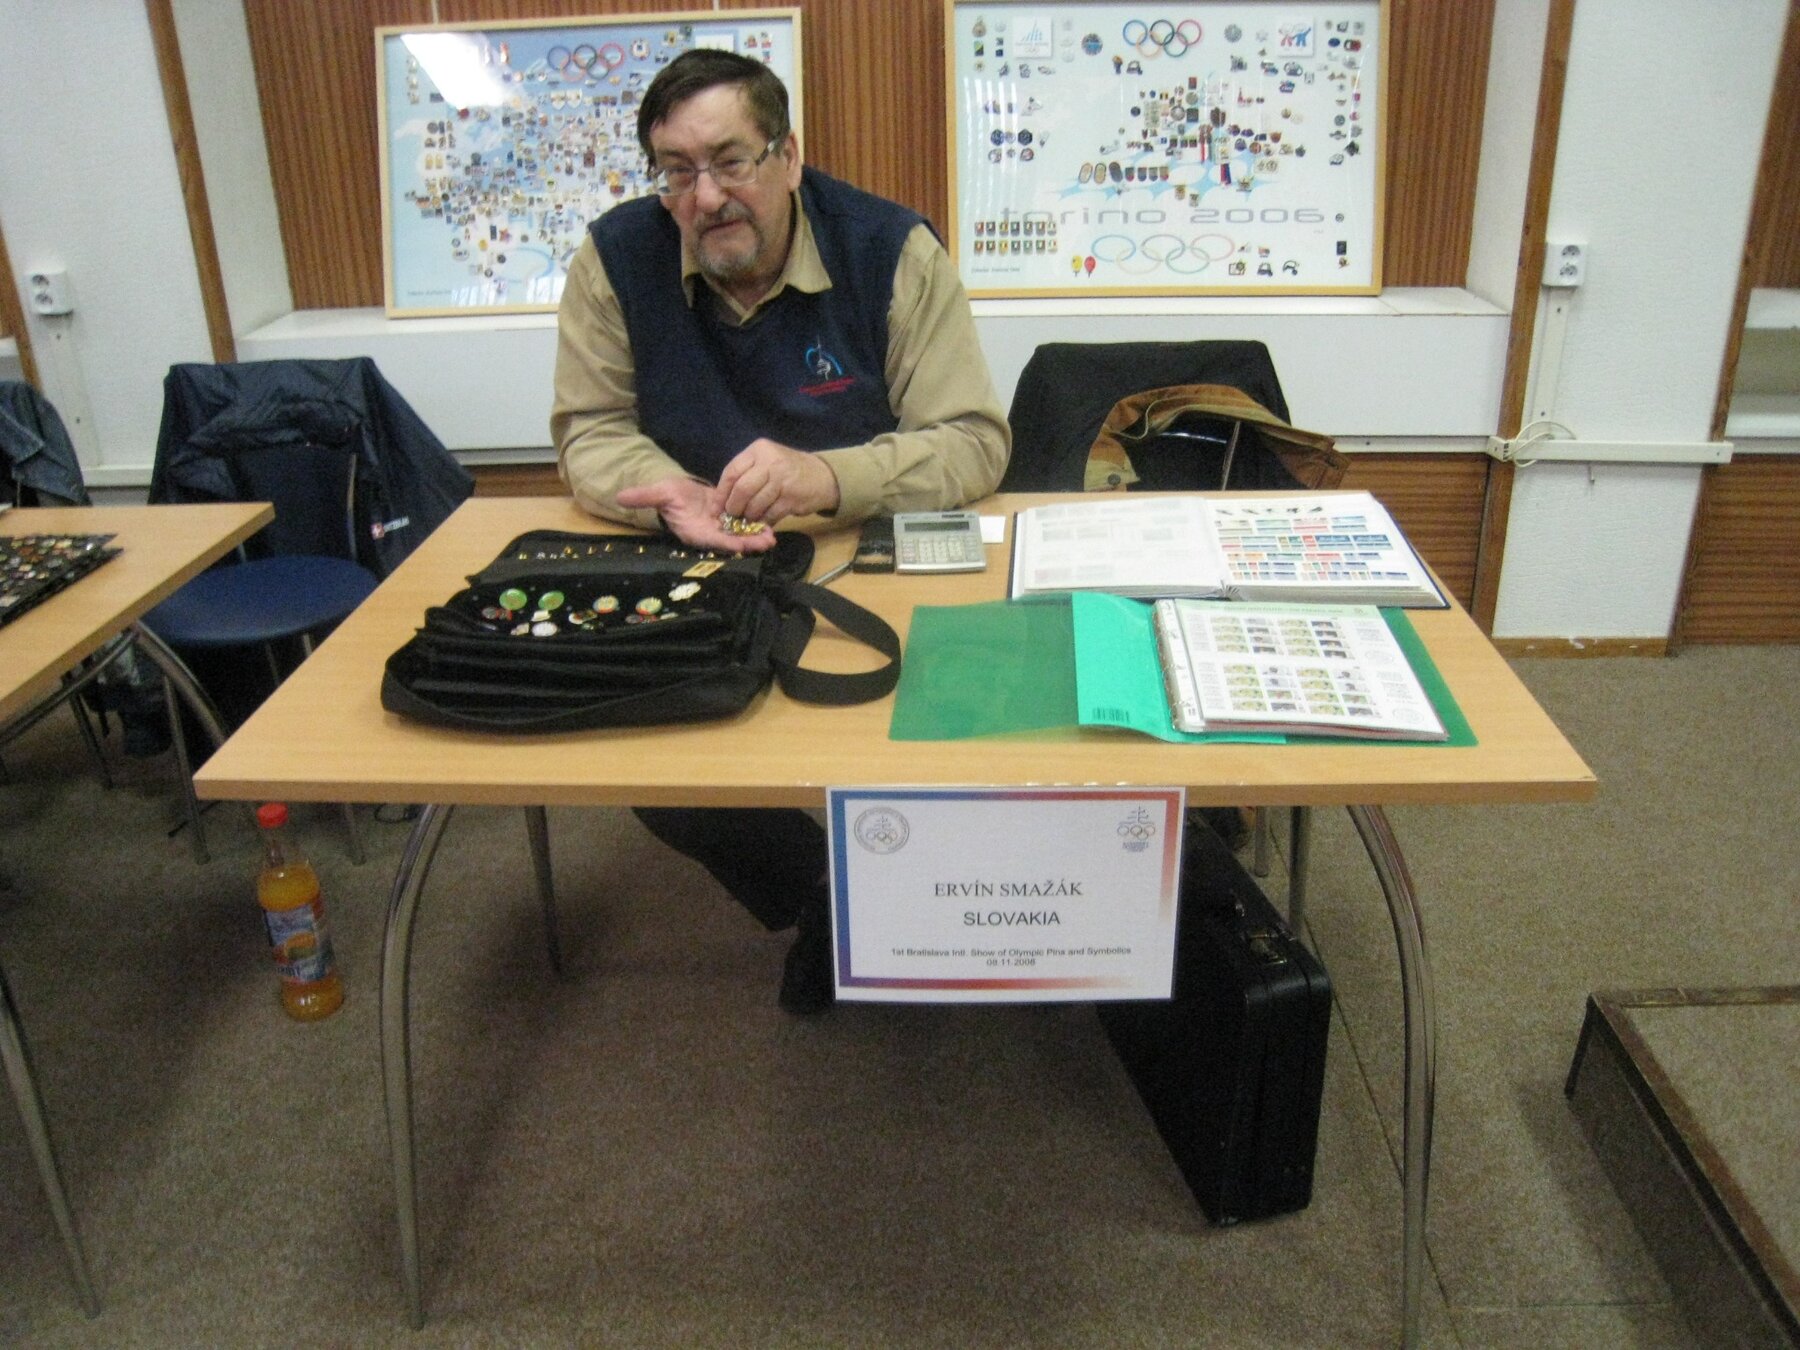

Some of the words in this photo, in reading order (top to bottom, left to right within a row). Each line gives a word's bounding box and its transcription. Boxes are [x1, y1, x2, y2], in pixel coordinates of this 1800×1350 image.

[1189, 207, 1325, 225] 2006
[934, 879, 994, 898] ERVÍN
[999, 878, 1084, 898] SMAŽÁK
[963, 911, 1061, 927] SLOVAKIA
[891, 947, 905, 957] 1st
[906, 947, 950, 958] Bratislava
[970, 947, 996, 958] Show
[997, 948, 1007, 957] of
[1008, 948, 1044, 959] Olympic
[1046, 948, 1066, 957] Pins
[1068, 947, 1085, 956] and
